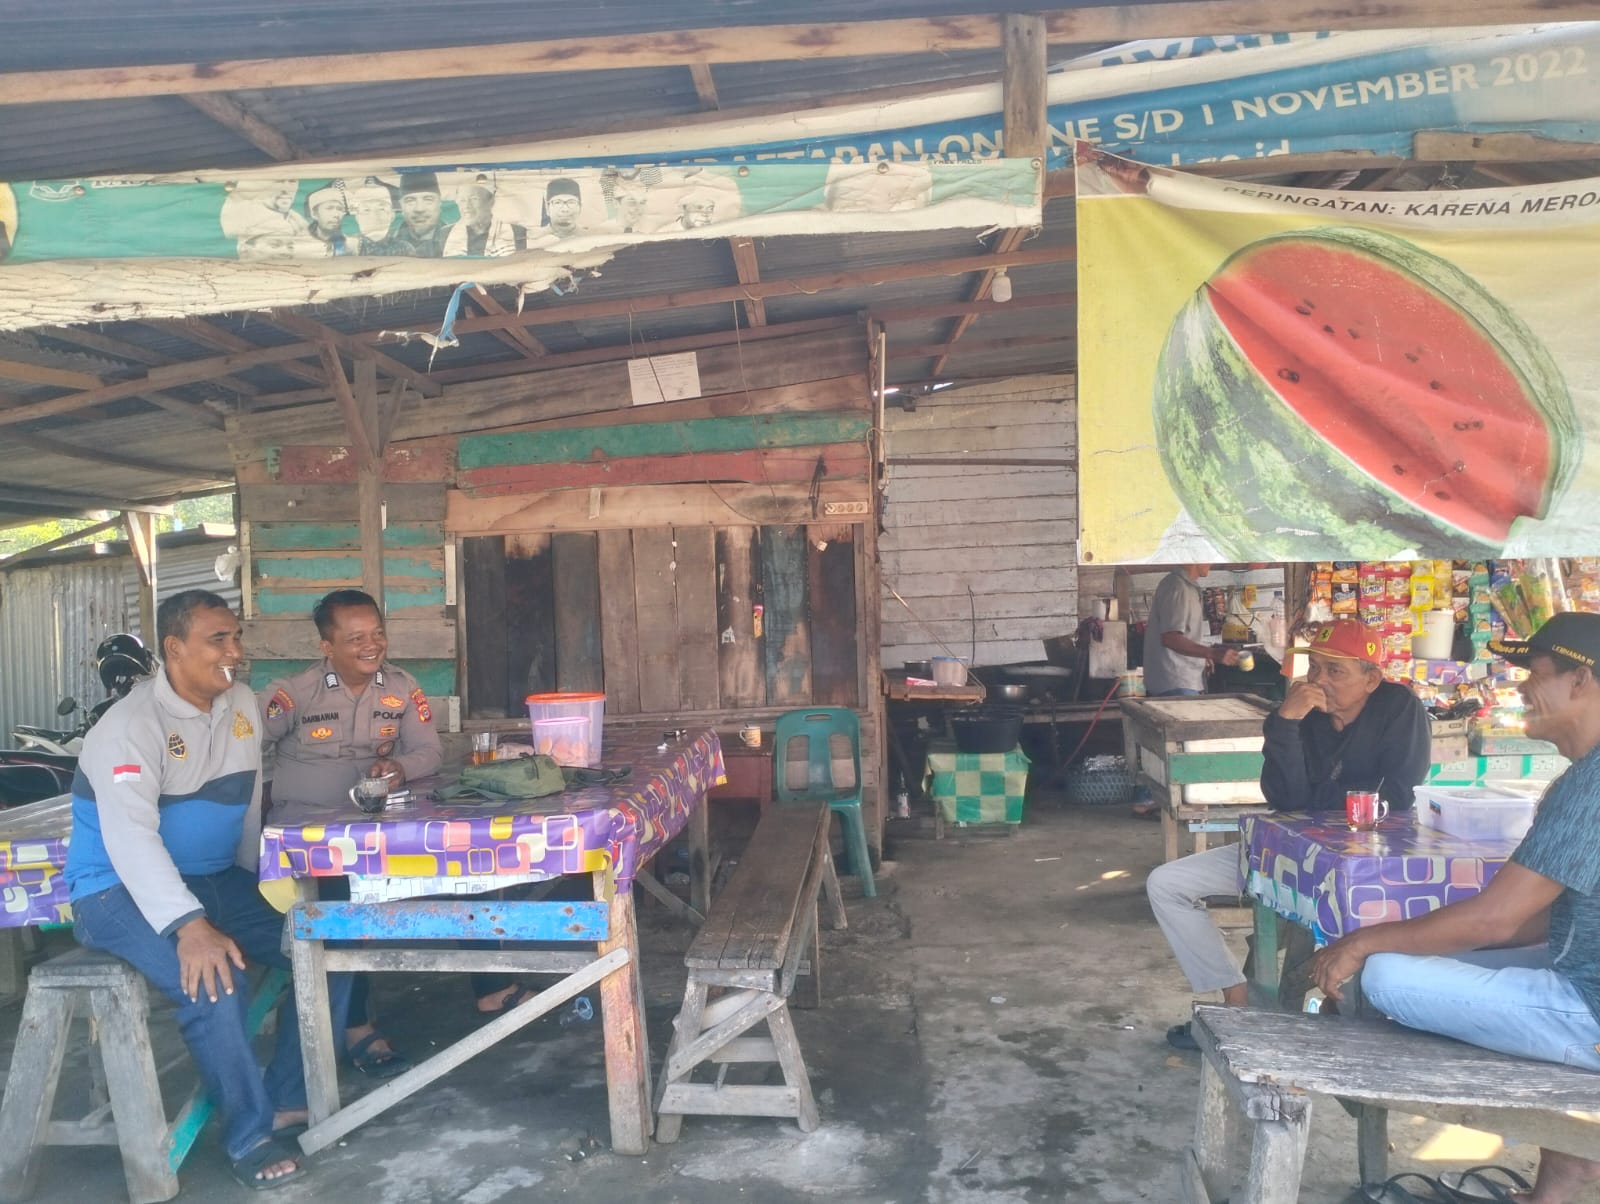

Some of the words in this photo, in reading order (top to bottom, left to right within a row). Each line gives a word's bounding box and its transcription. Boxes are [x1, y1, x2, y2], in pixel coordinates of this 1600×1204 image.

[937, 117, 1102, 154] ONNE
[1113, 108, 1184, 139] S/D
[1232, 63, 1480, 121] NOVEMBER
[1493, 46, 1588, 86] 2022
[1404, 202, 1511, 217] KARENA
[1520, 191, 1600, 214] MERO
[302, 711, 339, 724] DARMAWAN
